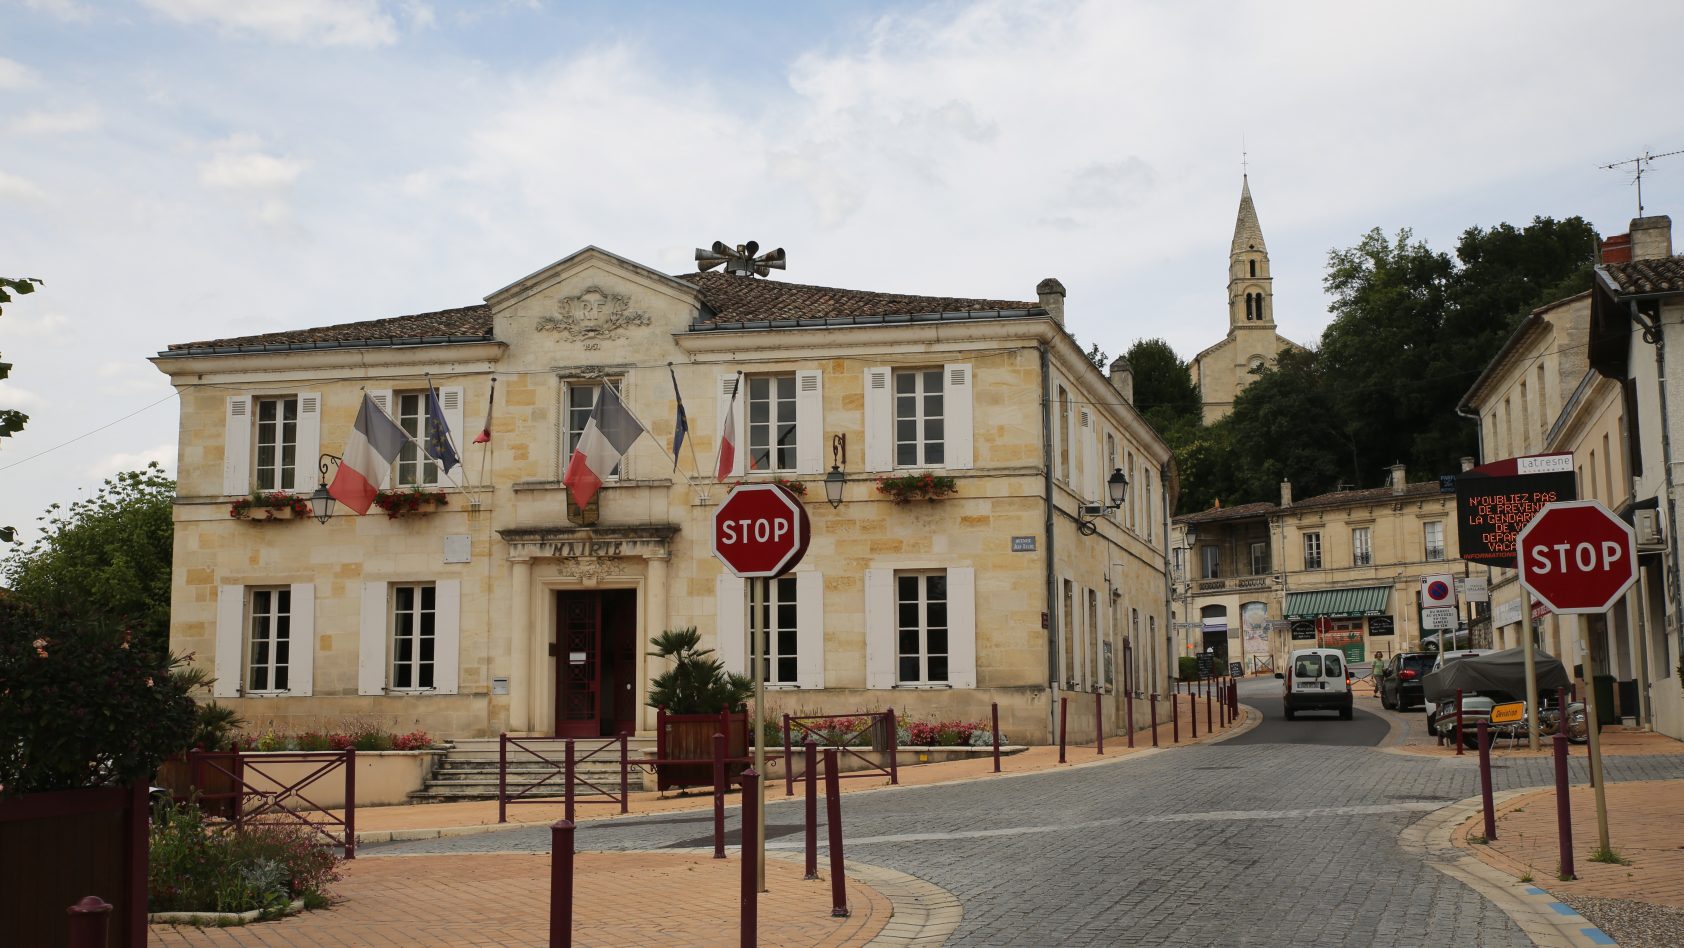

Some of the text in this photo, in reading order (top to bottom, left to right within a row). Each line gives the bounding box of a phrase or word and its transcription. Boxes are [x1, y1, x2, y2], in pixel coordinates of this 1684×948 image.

[1522, 457, 1570, 468] Latresne
[1469, 491, 1557, 507] N'OUBLIEZ PAS
[1478, 501, 1547, 515] DE PREVENI
[1469, 515, 1483, 525] LA
[721, 517, 789, 545] STOP
[1495, 523, 1510, 533] DE
[1482, 531, 1519, 543] DEPAR
[551, 542, 623, 556] MAIRIE
[1488, 541, 1517, 551] VACA
[1531, 541, 1622, 575] STOP
